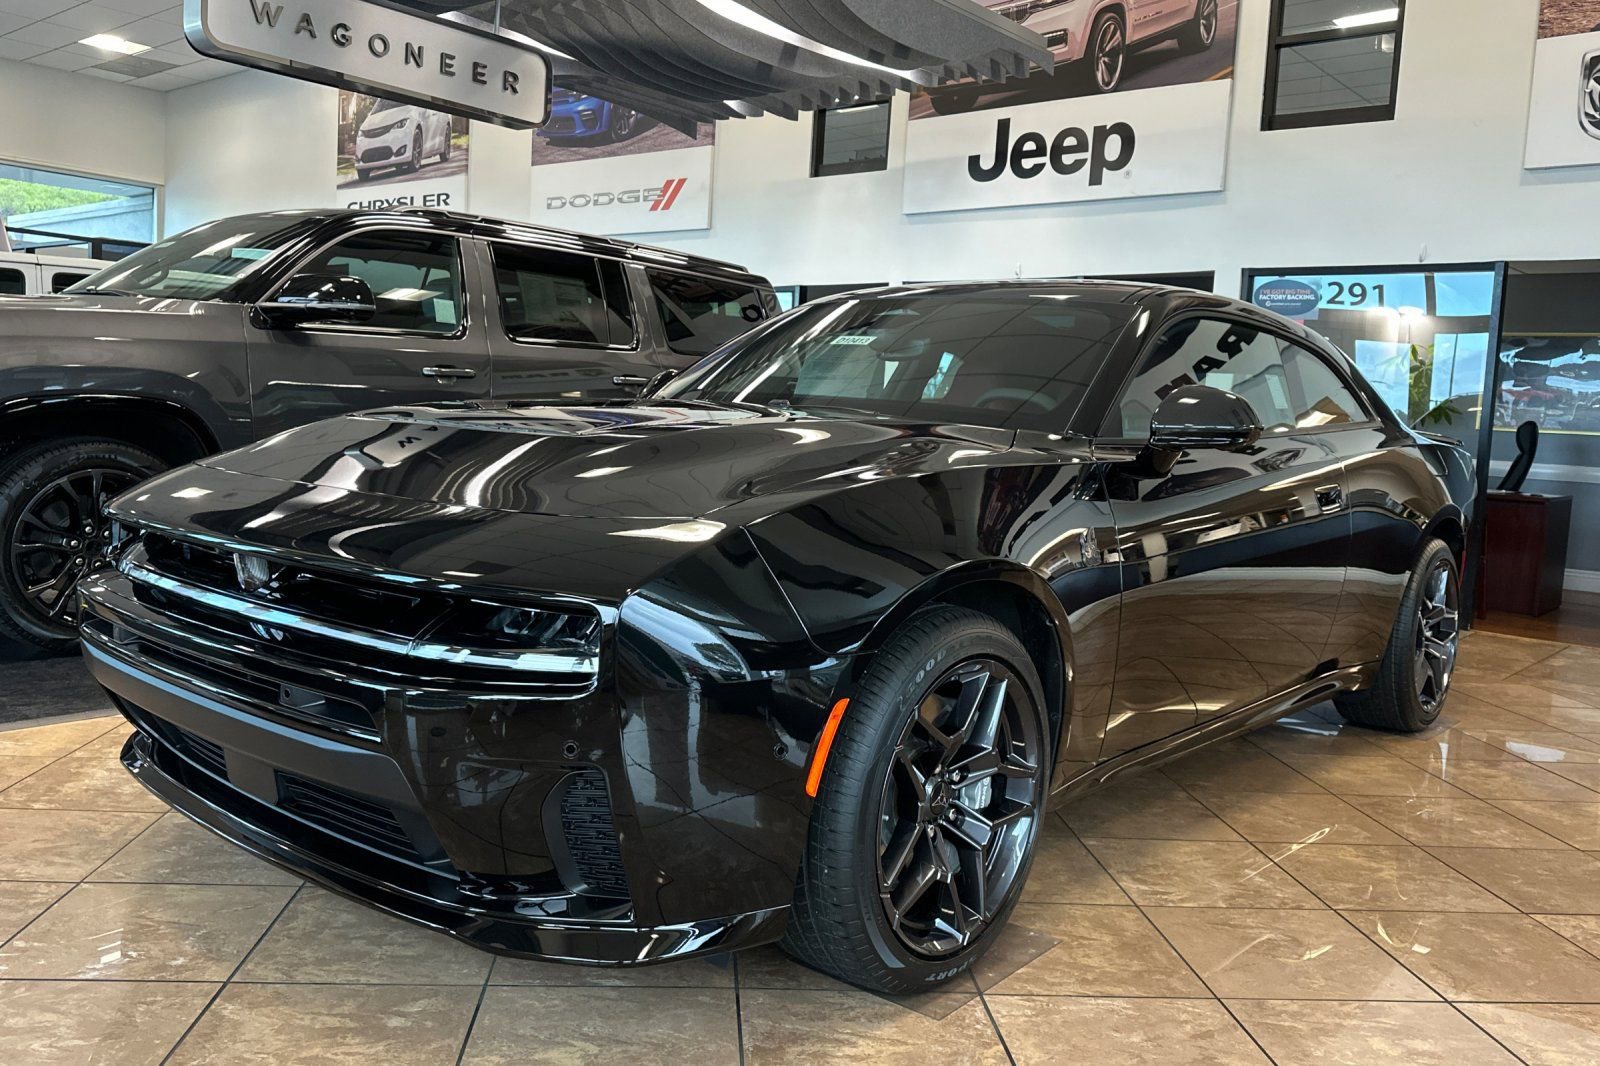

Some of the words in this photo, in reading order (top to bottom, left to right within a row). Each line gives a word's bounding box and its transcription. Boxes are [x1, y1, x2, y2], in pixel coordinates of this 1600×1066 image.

[249, 0, 520, 95] WAGONEER
[967, 117, 1136, 187] Jeep
[346, 192, 451, 210] CHRYSLER
[545, 186, 664, 211] DODGE
[1321, 281, 1385, 308] 291
